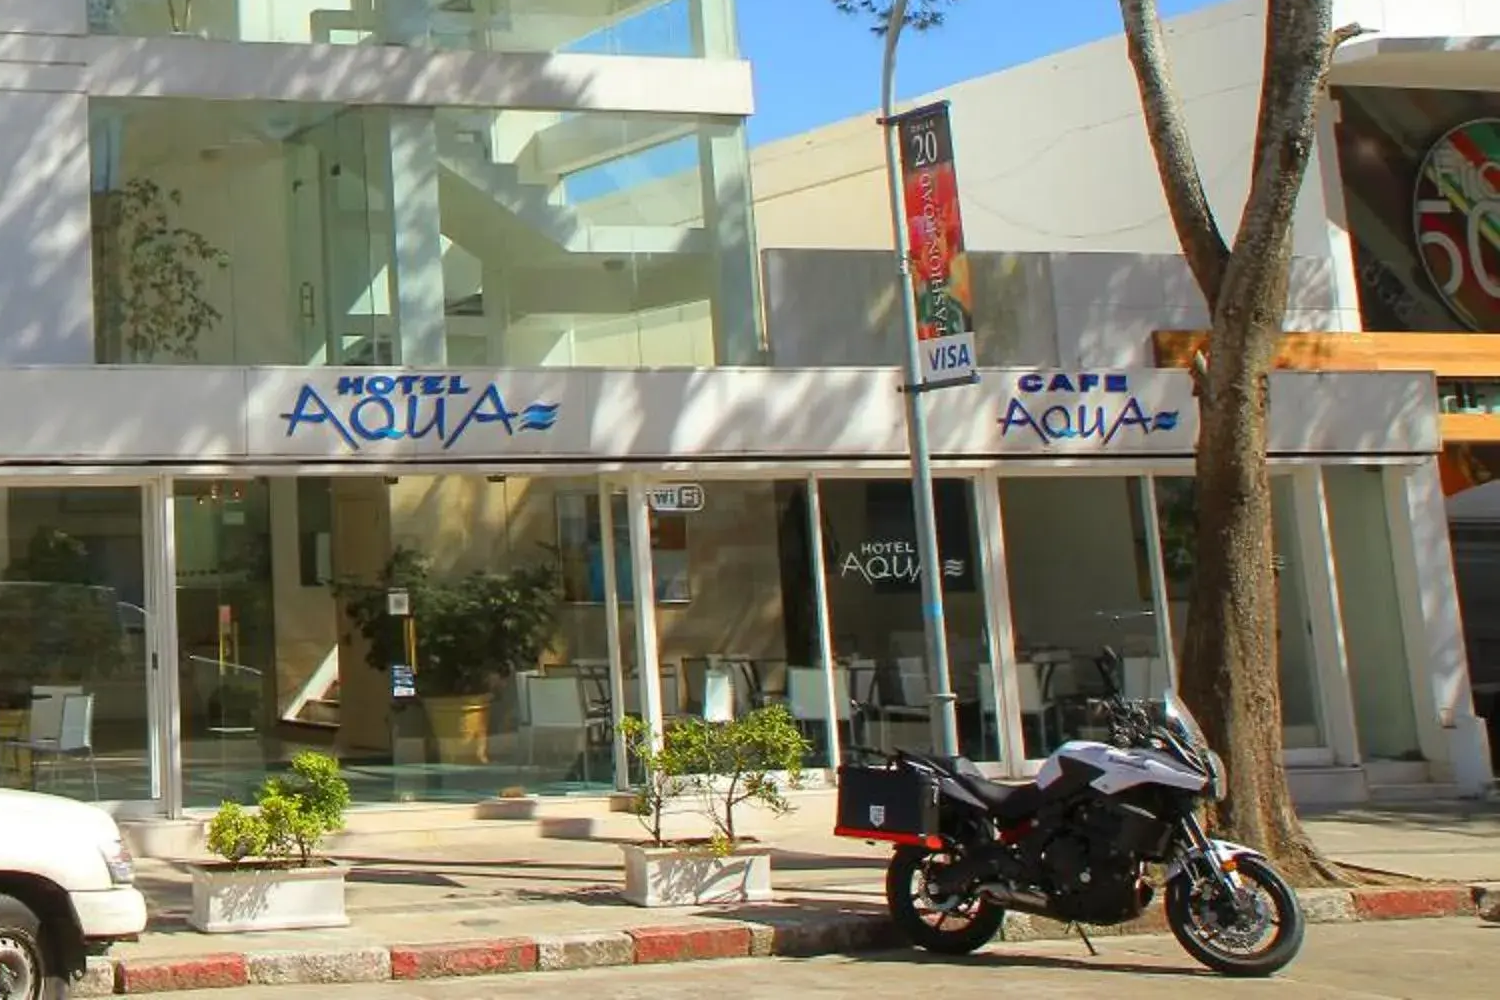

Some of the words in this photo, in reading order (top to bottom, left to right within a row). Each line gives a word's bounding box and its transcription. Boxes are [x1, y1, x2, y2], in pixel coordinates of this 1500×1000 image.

[911, 131, 937, 167] 20
[928, 343, 971, 370] VISA
[336, 375, 471, 397] HOTEL
[1018, 373, 1128, 393] CAFE
[280, 383, 519, 451] AQUA
[996, 396, 1152, 446] AQUA
[861, 541, 915, 555] HOTEL
